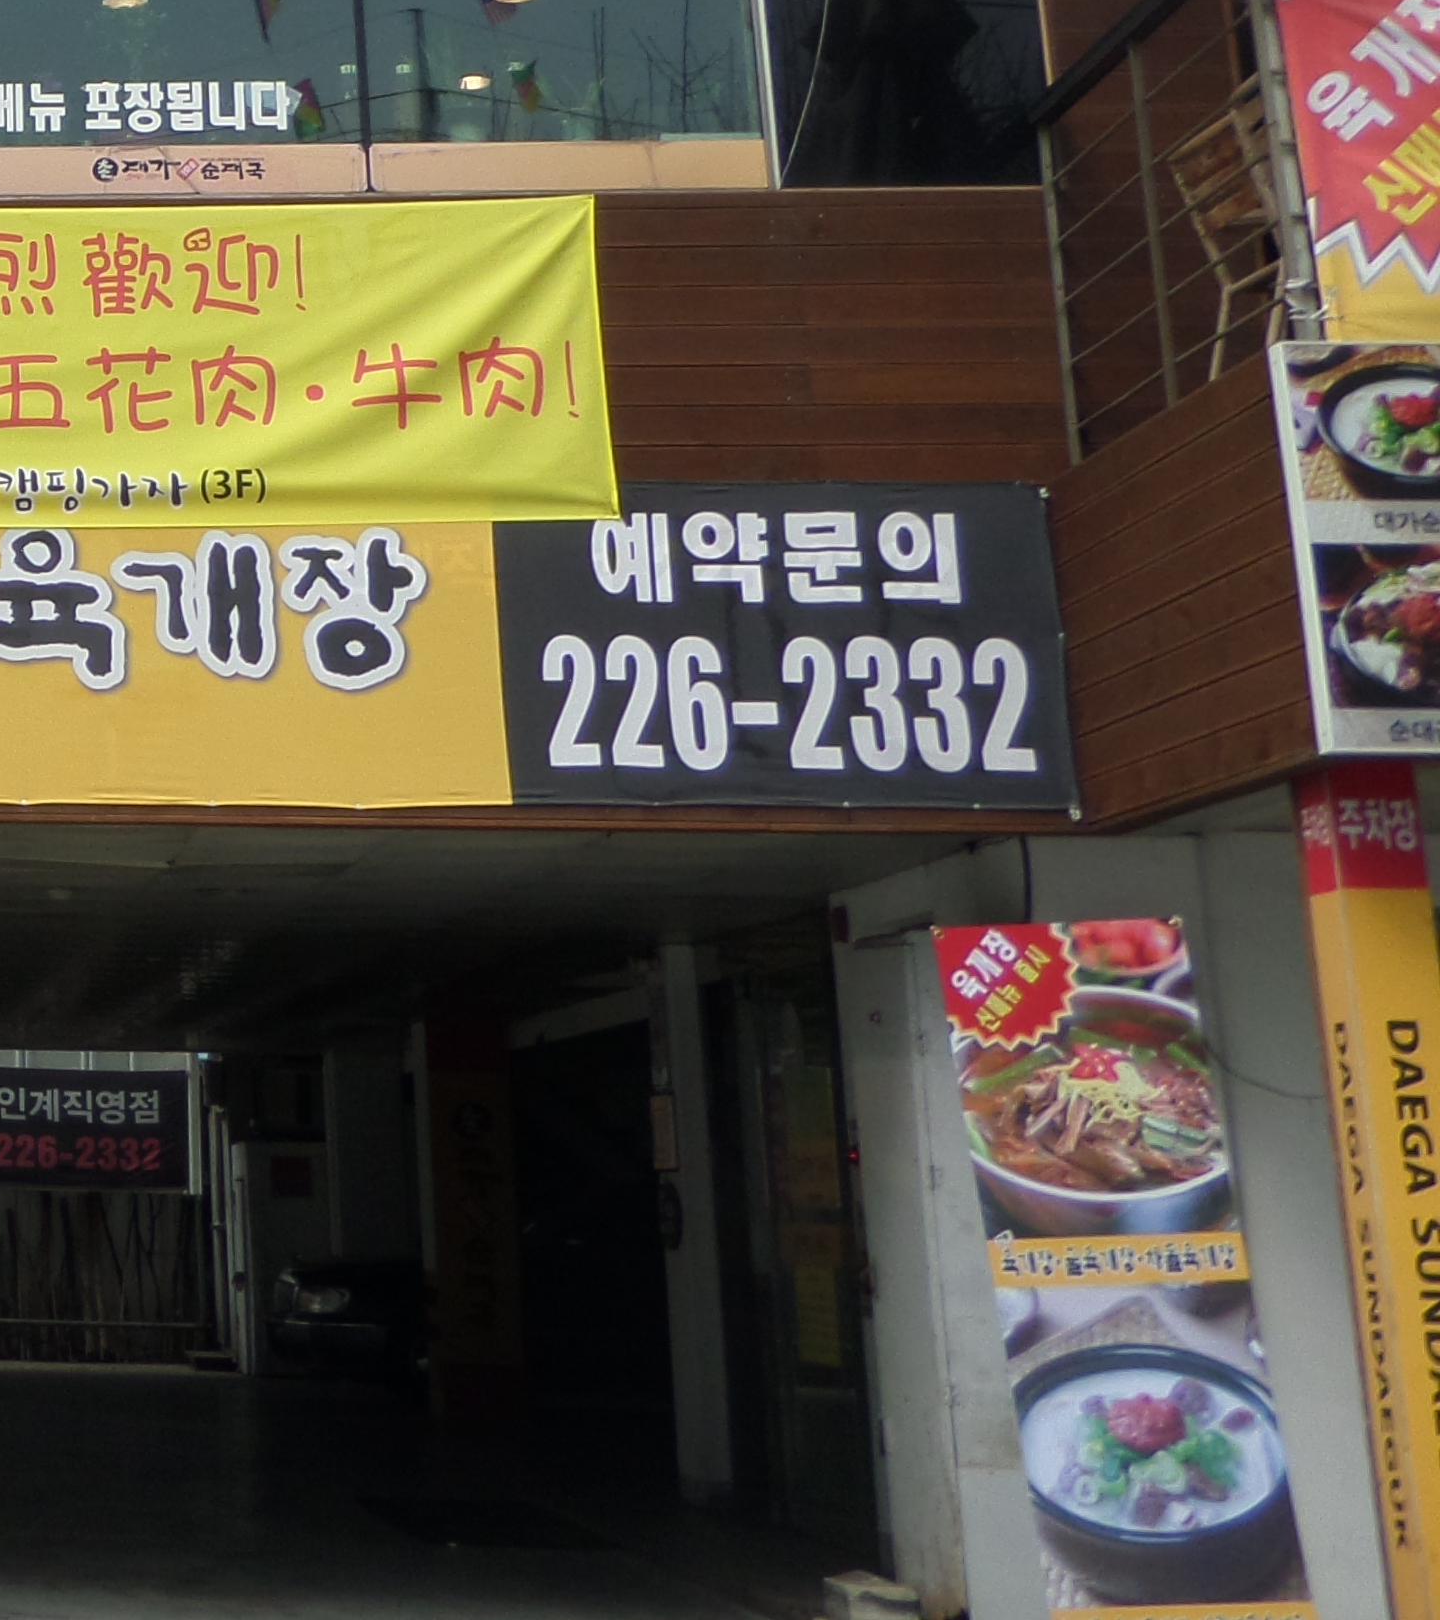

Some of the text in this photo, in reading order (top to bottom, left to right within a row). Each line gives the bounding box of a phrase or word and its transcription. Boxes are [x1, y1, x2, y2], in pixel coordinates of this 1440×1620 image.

[85, 80, 290, 132] 포장됩니다
[200, 468, 266, 504] (3F)
[590, 512, 963, 608] 예약문의
[544, 634, 1041, 776] 226-2332
[1338, 798, 1417, 852] 주차장
[950, 928, 1019, 999] 육개장
[1386, 1019, 1437, 1196] DAEGA
